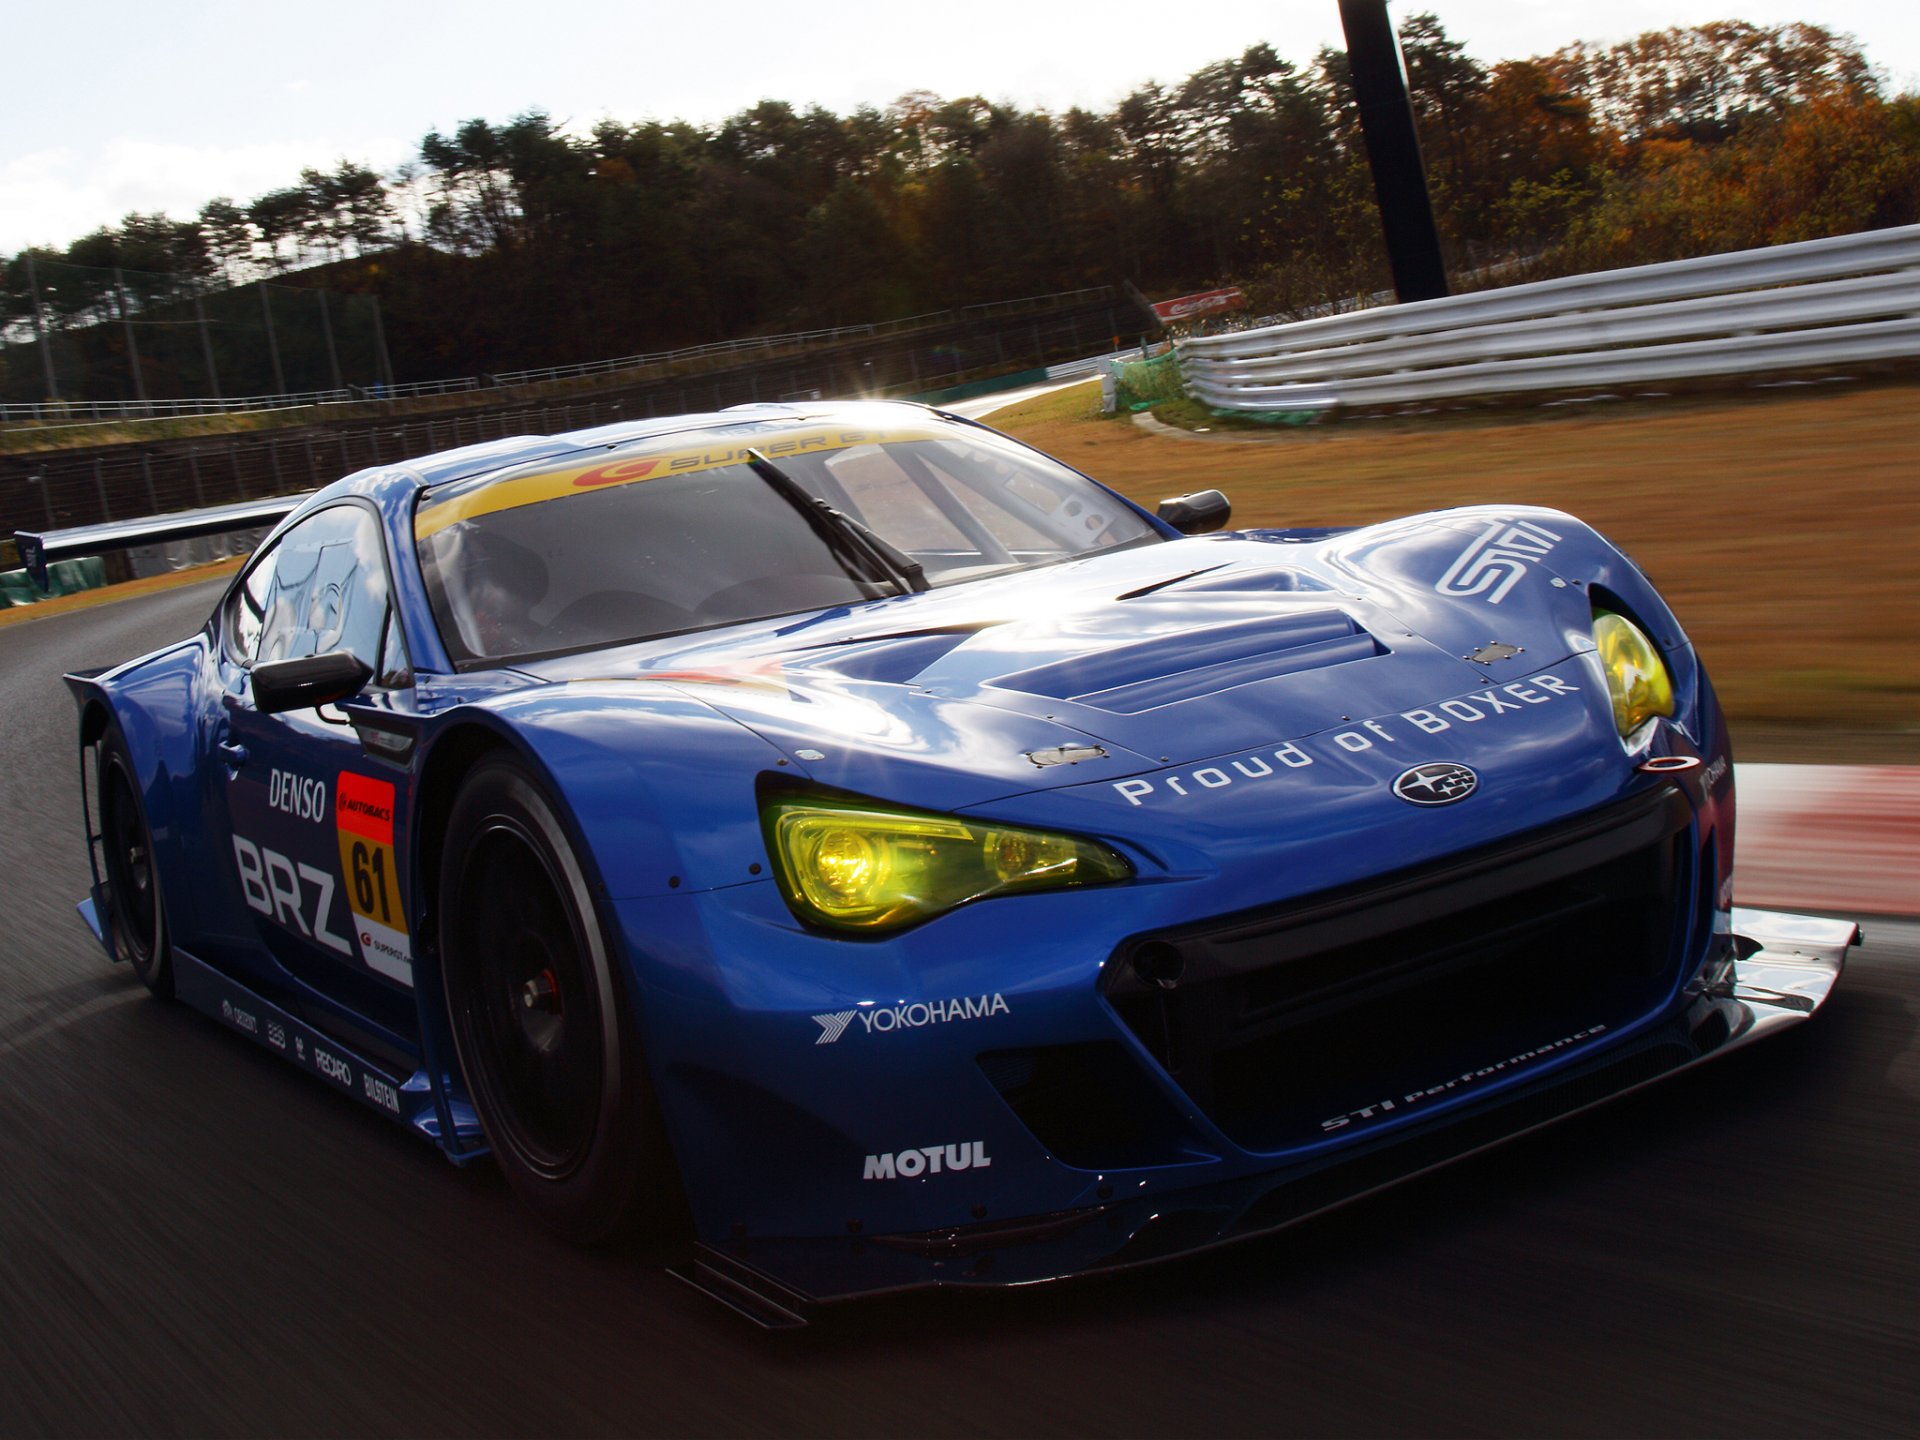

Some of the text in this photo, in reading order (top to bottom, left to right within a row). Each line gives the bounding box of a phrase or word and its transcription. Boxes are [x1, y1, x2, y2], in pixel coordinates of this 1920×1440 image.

[670, 436, 828, 471] SUPER
[1112, 674, 1581, 806] Proud of BOXER
[269, 767, 326, 824] DENSO
[347, 798, 391, 822] AUTOBACS
[232, 834, 353, 957] BRZ
[352, 840, 392, 924] 61
[858, 992, 1011, 1033] YOKOHAMA
[314, 1047, 352, 1086] RECARO
[363, 1072, 401, 1114] BILSTEIN
[1320, 1099, 1396, 1132] STI
[863, 1140, 992, 1180] MOTUL
